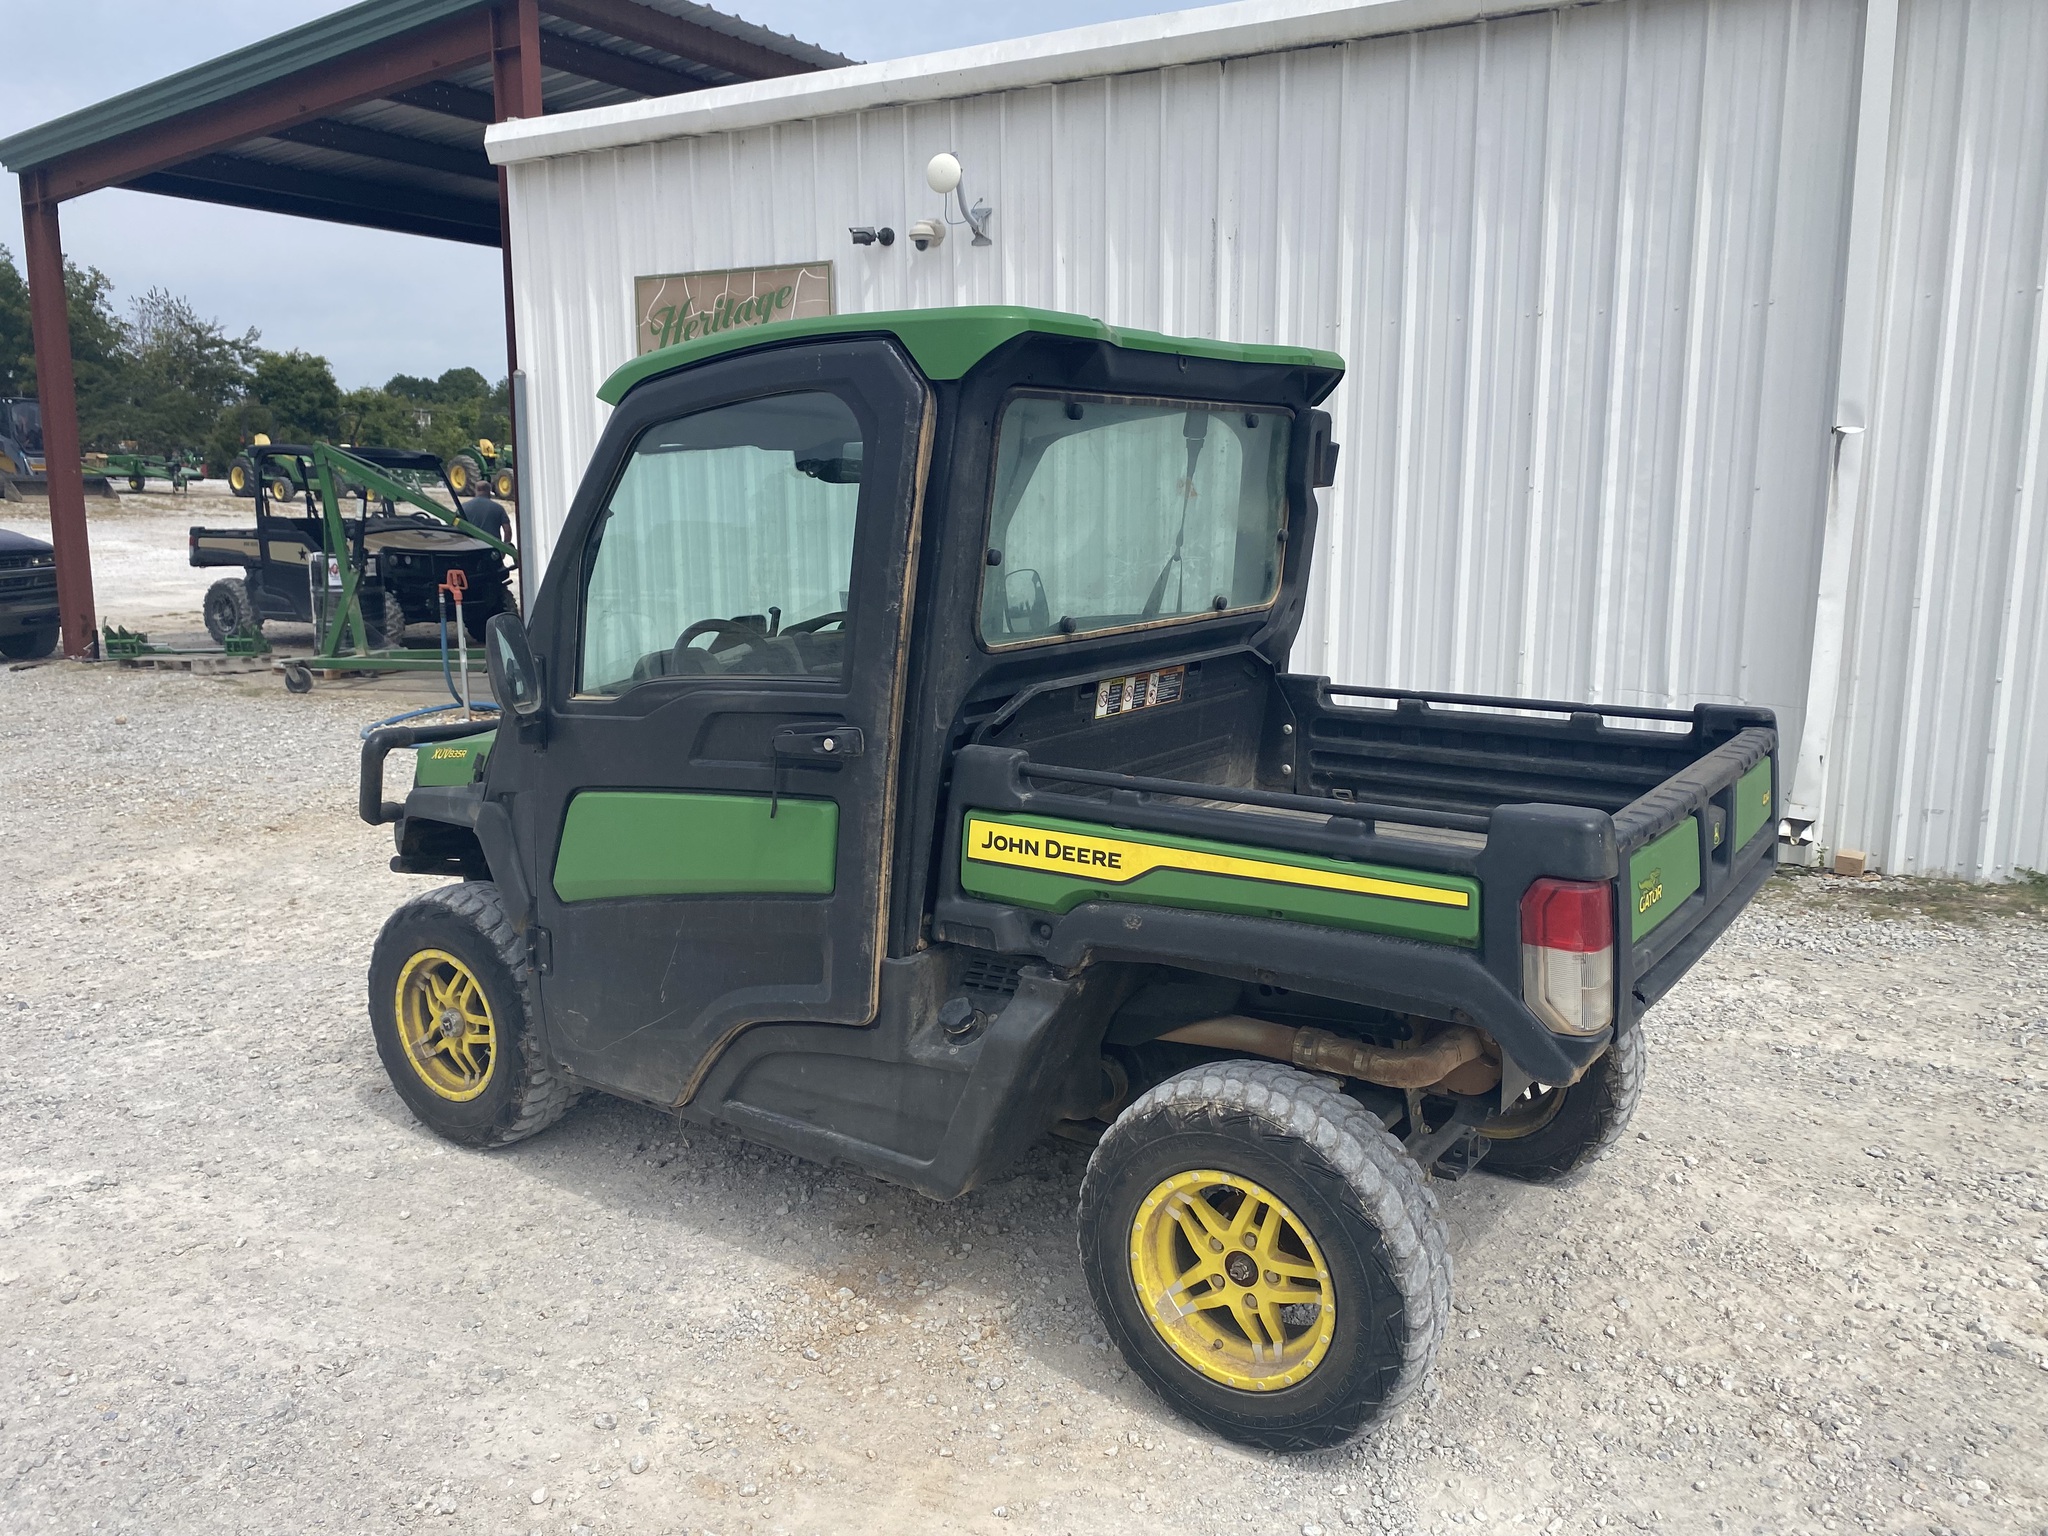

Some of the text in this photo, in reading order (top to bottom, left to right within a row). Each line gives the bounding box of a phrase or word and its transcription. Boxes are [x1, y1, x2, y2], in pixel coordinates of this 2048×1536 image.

[650, 286, 793, 350] Heritage
[981, 831, 1122, 869] JOHN DEERE
[1639, 884, 1662, 913] GATOR
